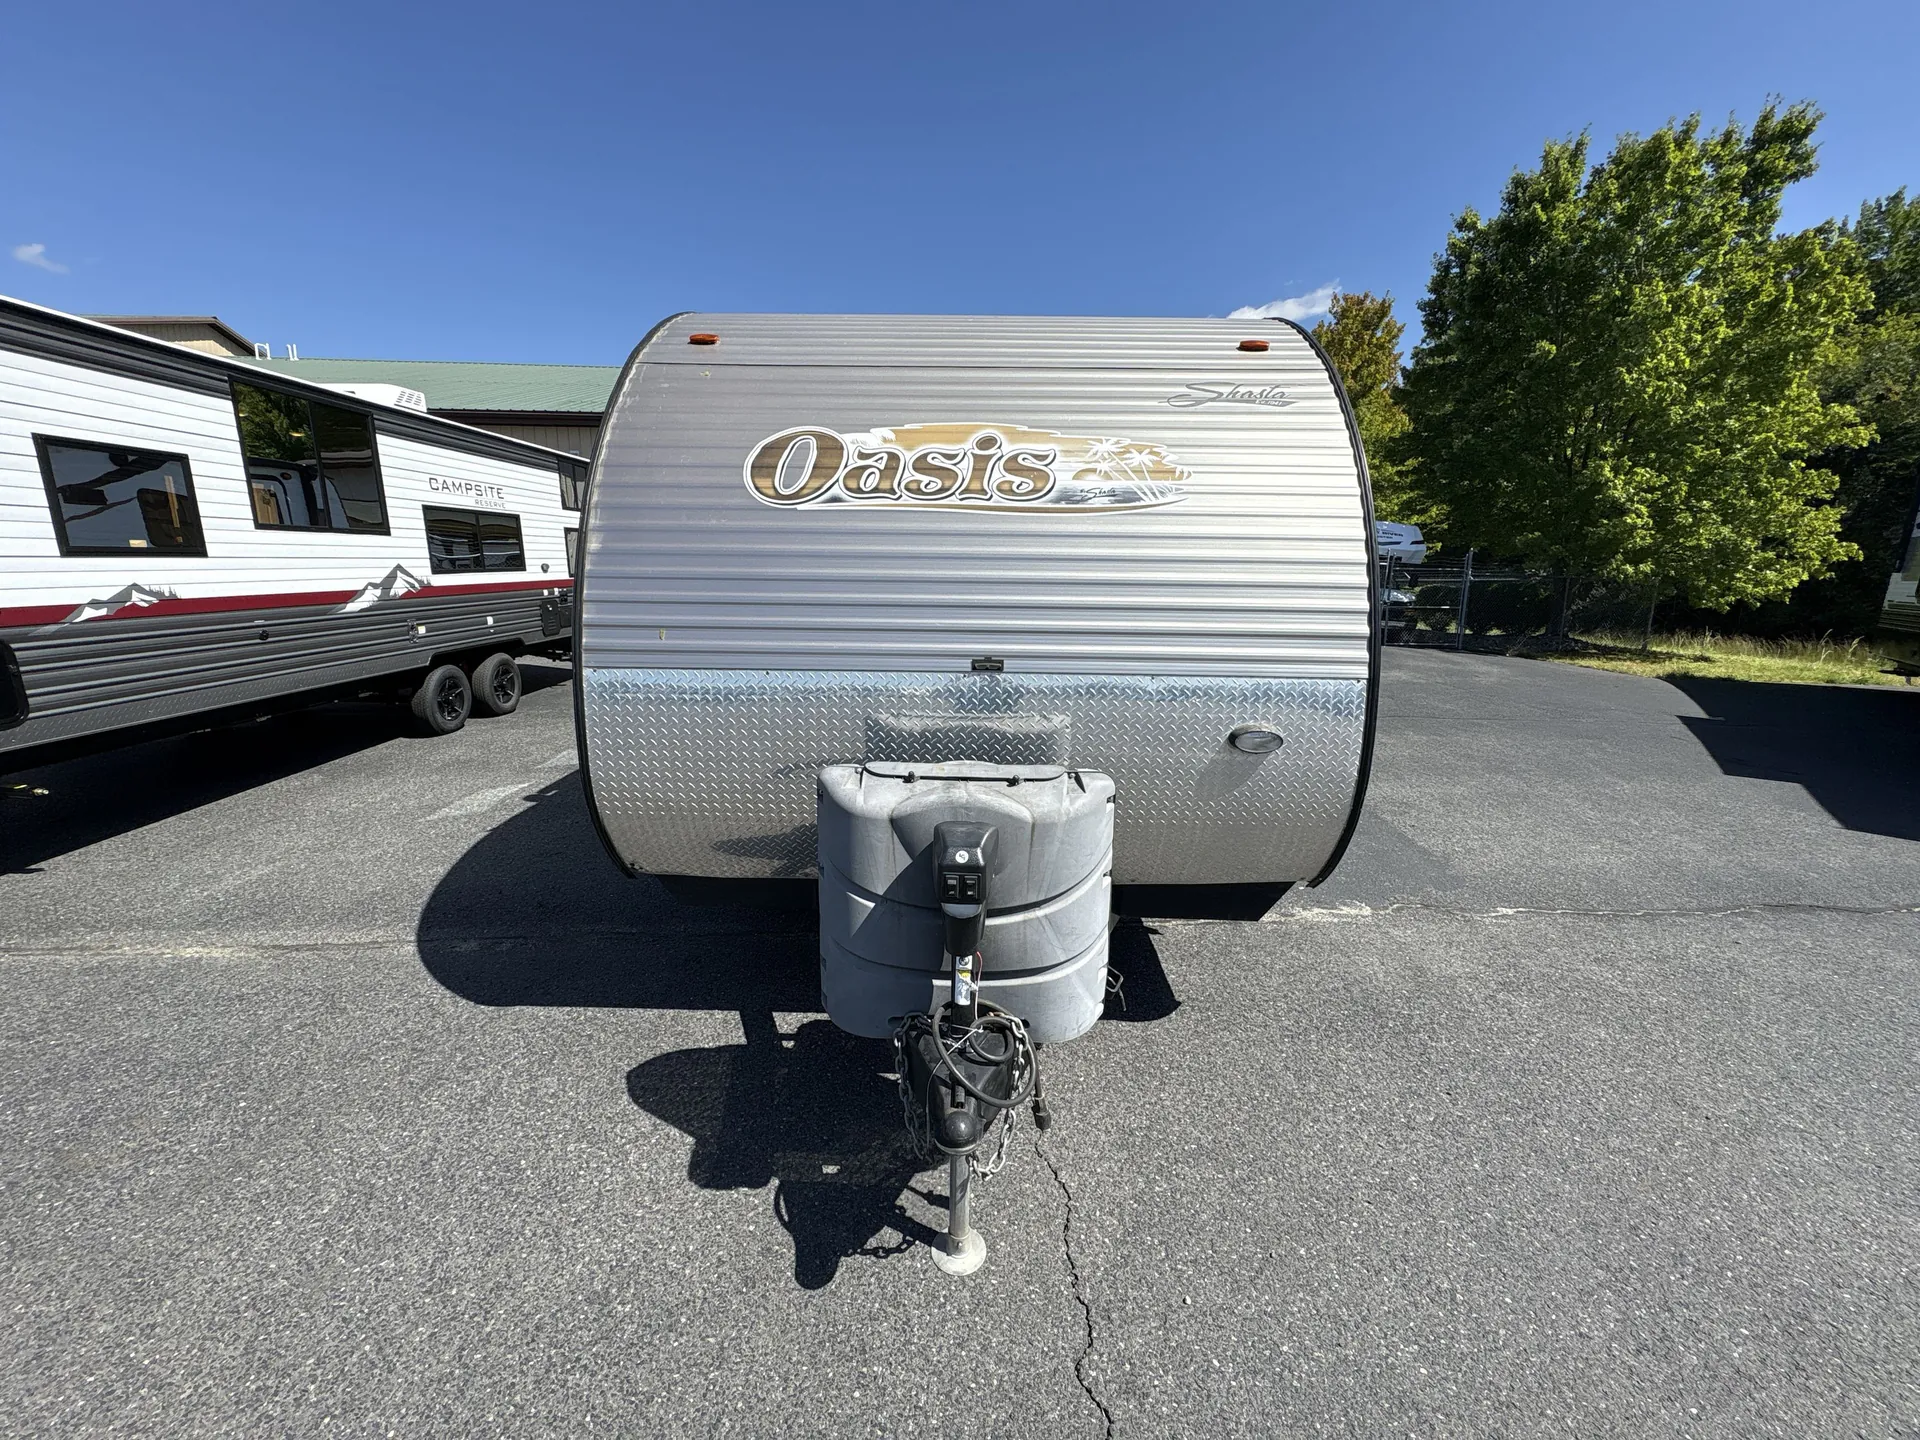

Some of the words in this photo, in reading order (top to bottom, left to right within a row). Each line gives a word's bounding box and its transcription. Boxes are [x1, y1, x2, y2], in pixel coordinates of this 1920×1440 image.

[1164, 381, 1293, 408] Shasta
[743, 426, 1057, 508] Oasis
[428, 477, 505, 500] CAMPSITE
[474, 499, 507, 509] RESERVE
